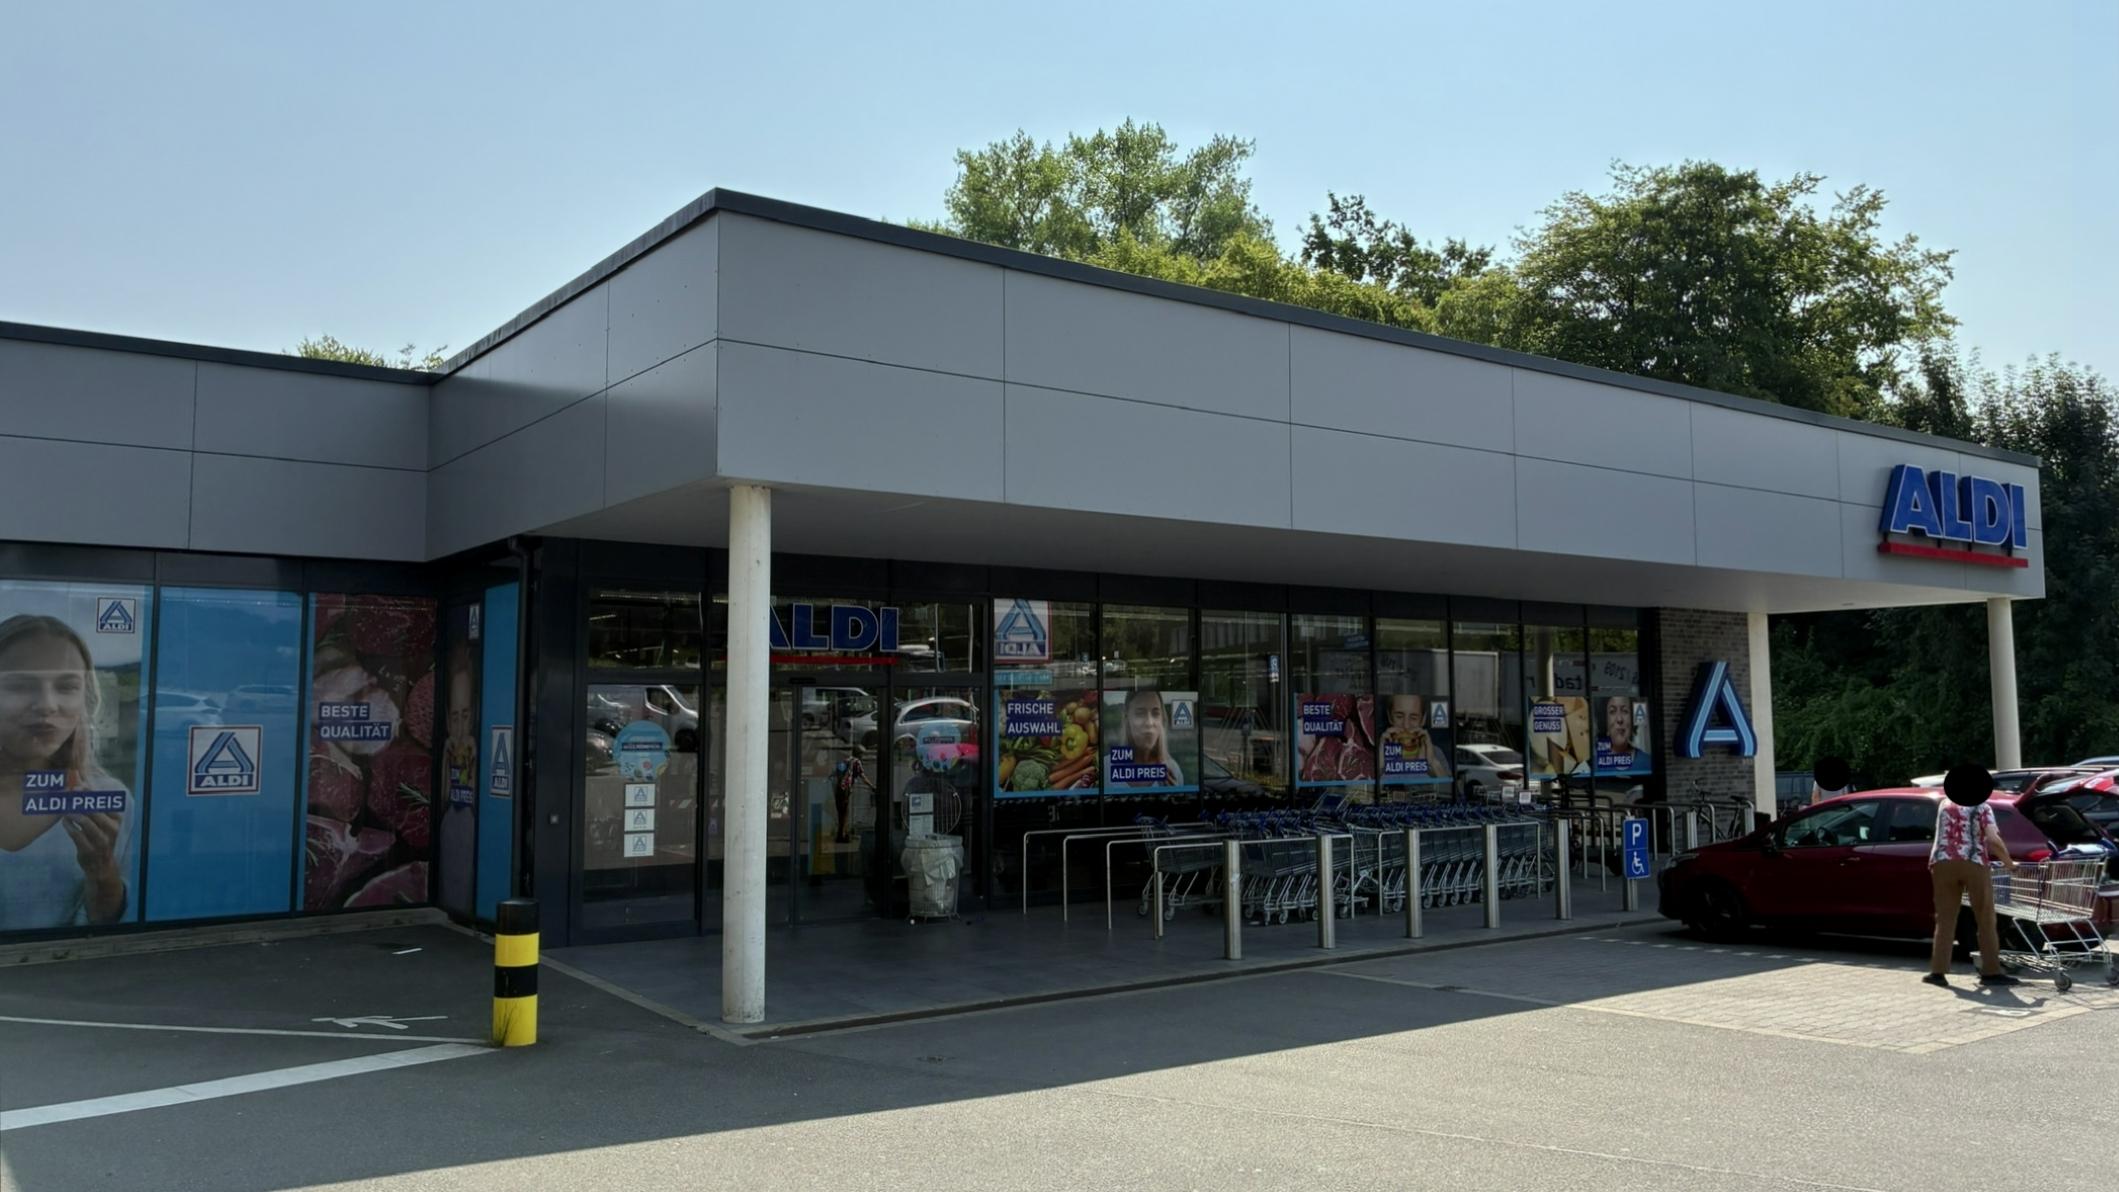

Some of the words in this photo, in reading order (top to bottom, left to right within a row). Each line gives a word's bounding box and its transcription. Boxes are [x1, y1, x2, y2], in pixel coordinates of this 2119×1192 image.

[1886, 464, 2028, 549] ALDI
[321, 705, 368, 717] BESTE
[1007, 702, 1054, 714] FRISCHE
[1303, 704, 1330, 715] BESTE
[1534, 706, 1565, 715] GROSSER
[320, 722, 389, 738] QUALITÄT
[1007, 721, 1060, 733] AUSWAHL
[1304, 719, 1343, 731] QUALITÄT
[1534, 720, 1560, 730] GENUSS
[1111, 748, 1133, 760] ZUM
[1384, 745, 1402, 756] ZUM
[1598, 756, 1613, 765] ALDI
[1614, 755, 1632, 764] PREIS
[1385, 762, 1403, 772] ALDI
[1405, 761, 1428, 771] PREIS
[1112, 767, 1135, 779] ALDI
[1137, 767, 1166, 778] PREIS
[26, 774, 64, 787] ZUM
[200, 774, 249, 787] ALDI
[25, 797, 66, 811] ALDI
[72, 796, 123, 810] PREIS
[1632, 823, 1642, 846] P
